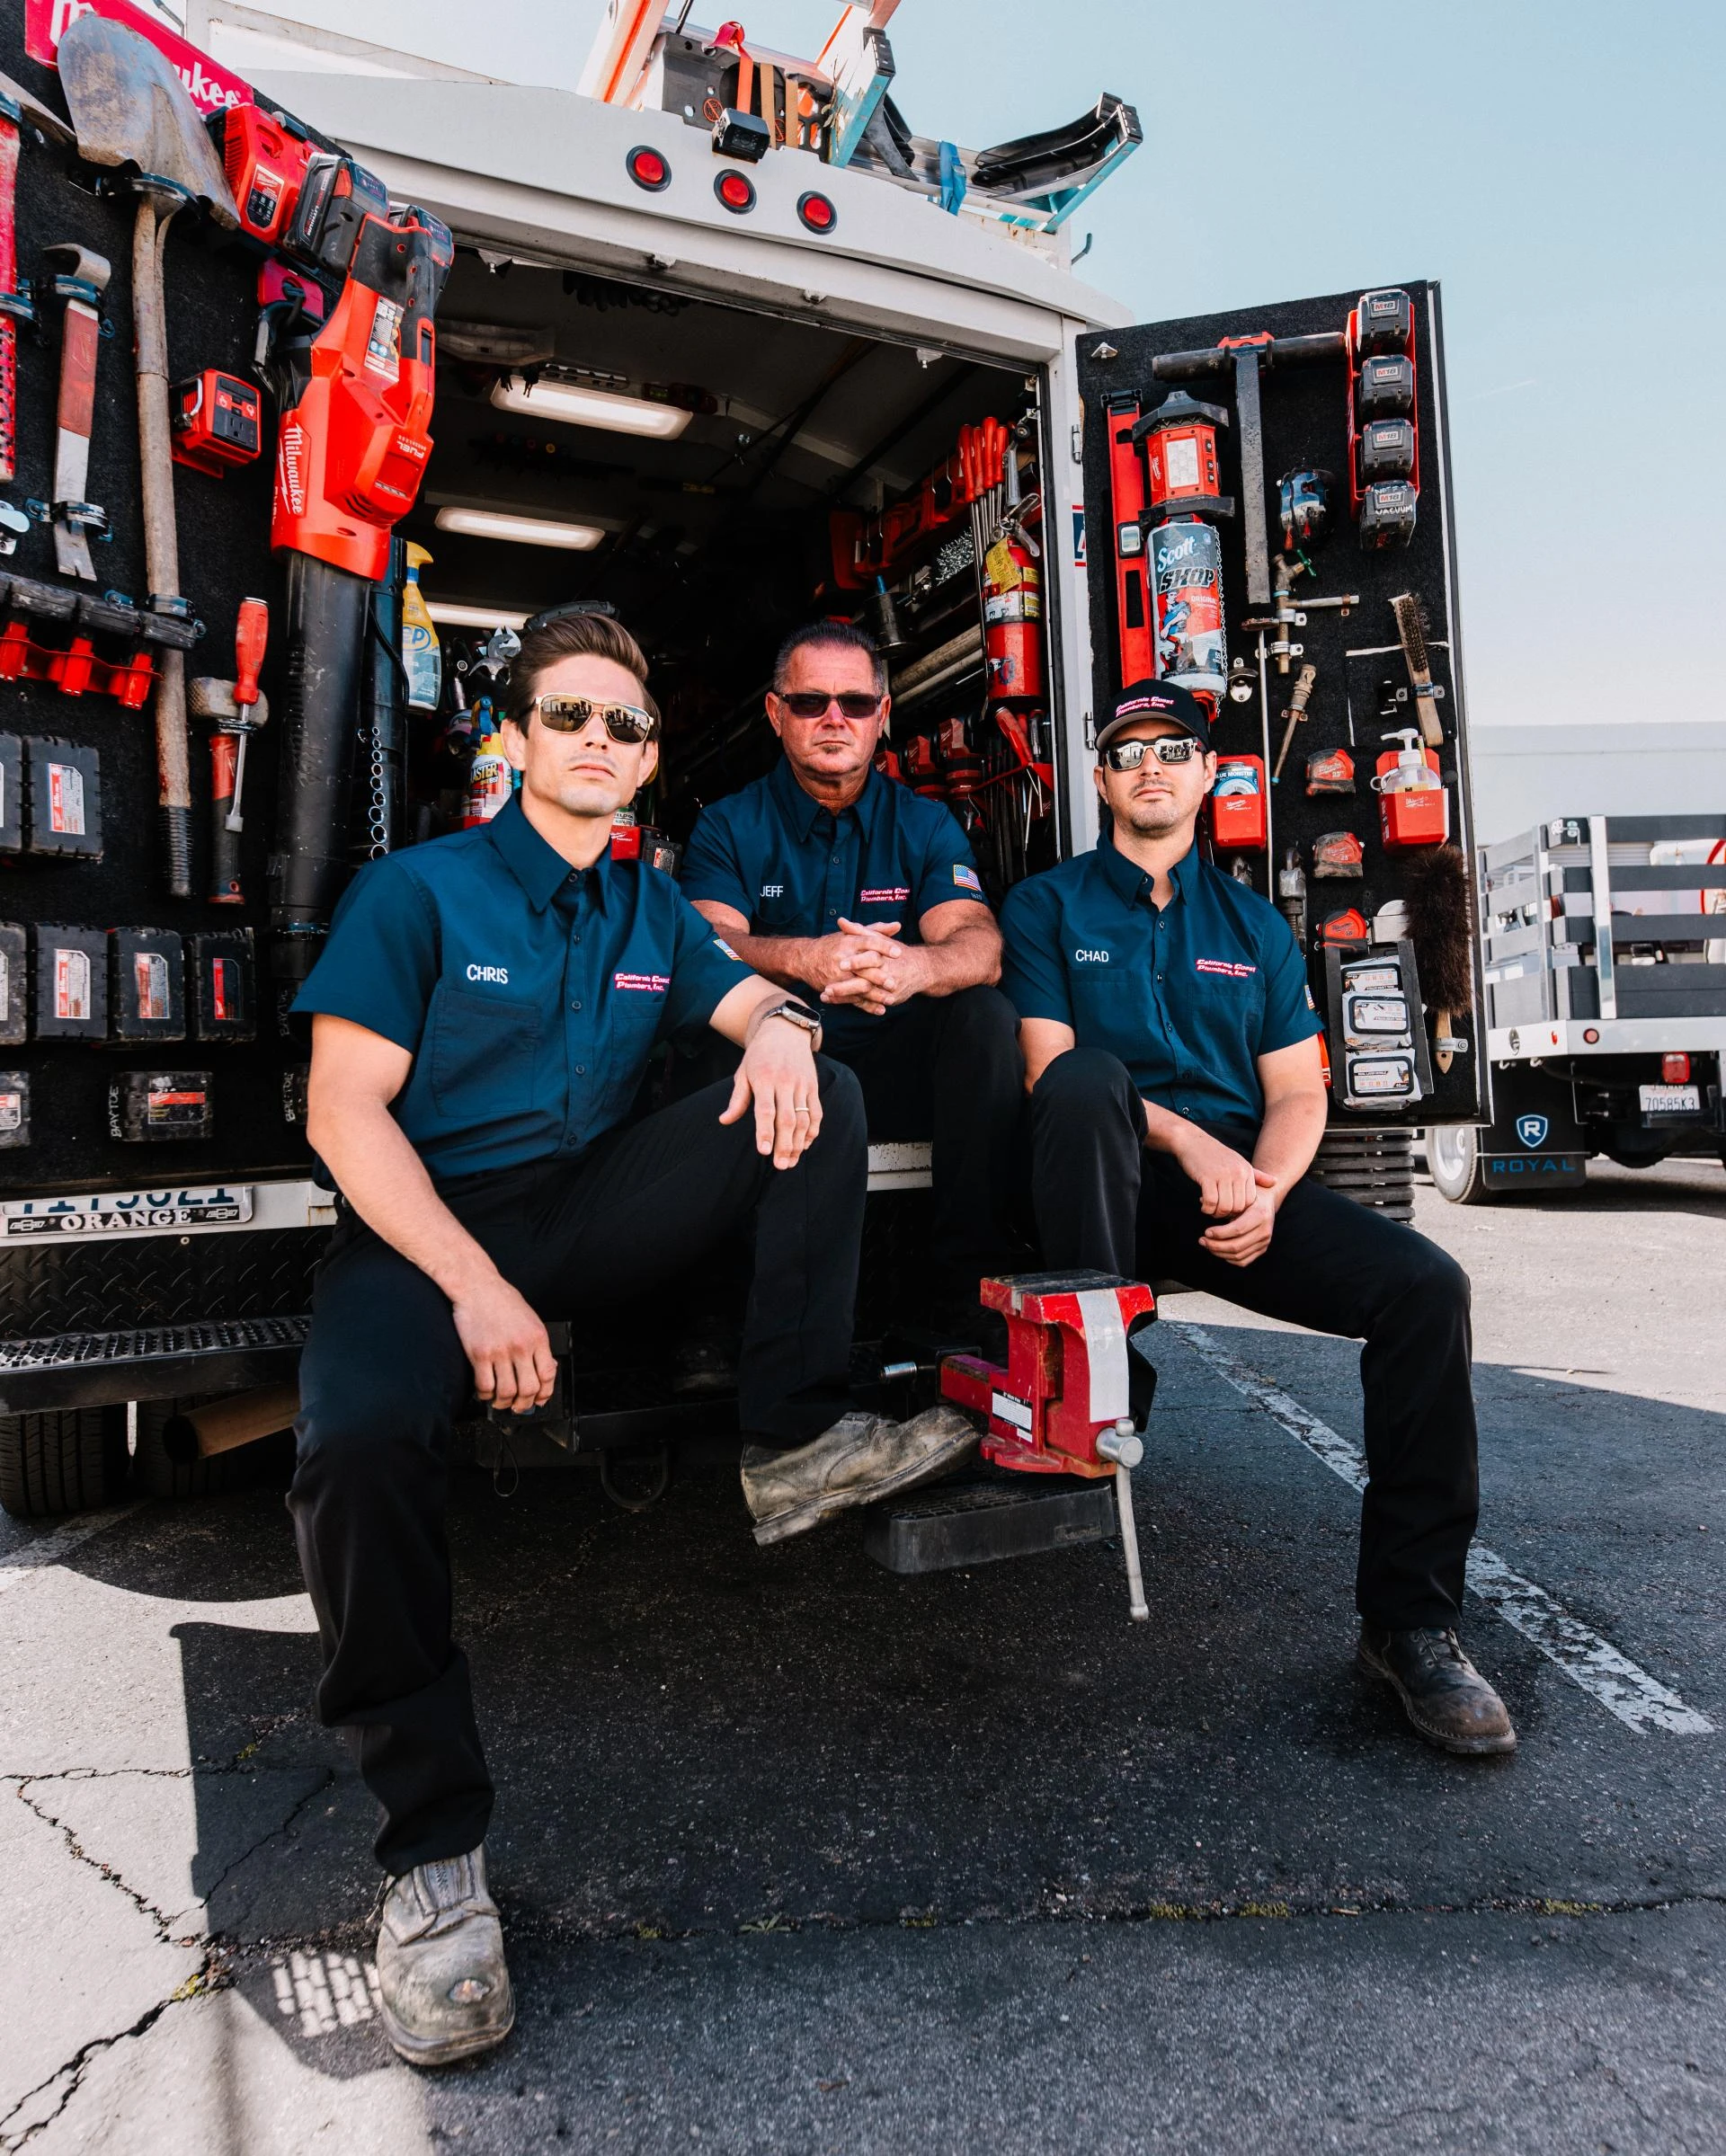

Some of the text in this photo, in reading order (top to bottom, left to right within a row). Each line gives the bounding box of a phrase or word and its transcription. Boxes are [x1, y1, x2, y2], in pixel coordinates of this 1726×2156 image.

[396, 440, 425, 459] FUEL
[283, 422, 304, 514] Milwaukee
[1375, 504, 1413, 516] VACUUM
[1157, 536, 1194, 572] Scott
[1160, 567, 1215, 595] SHOP
[402, 627, 425, 644] ep
[1116, 696, 1174, 713] California Coast
[761, 885, 783, 898] JEFF
[1075, 949, 1109, 963] CHAD
[467, 964, 509, 984] CHRIS
[1197, 959, 1256, 973] California Coast
[1197, 964, 1249, 978] Plumbers, Inc.
[615, 973, 651, 982] California
[616, 981, 664, 991] Plumbers, Inc.
[1524, 1121, 1541, 1137] R
[1492, 1159, 1576, 1174] ROYAL
[60, 1208, 191, 1230] ORANGE
